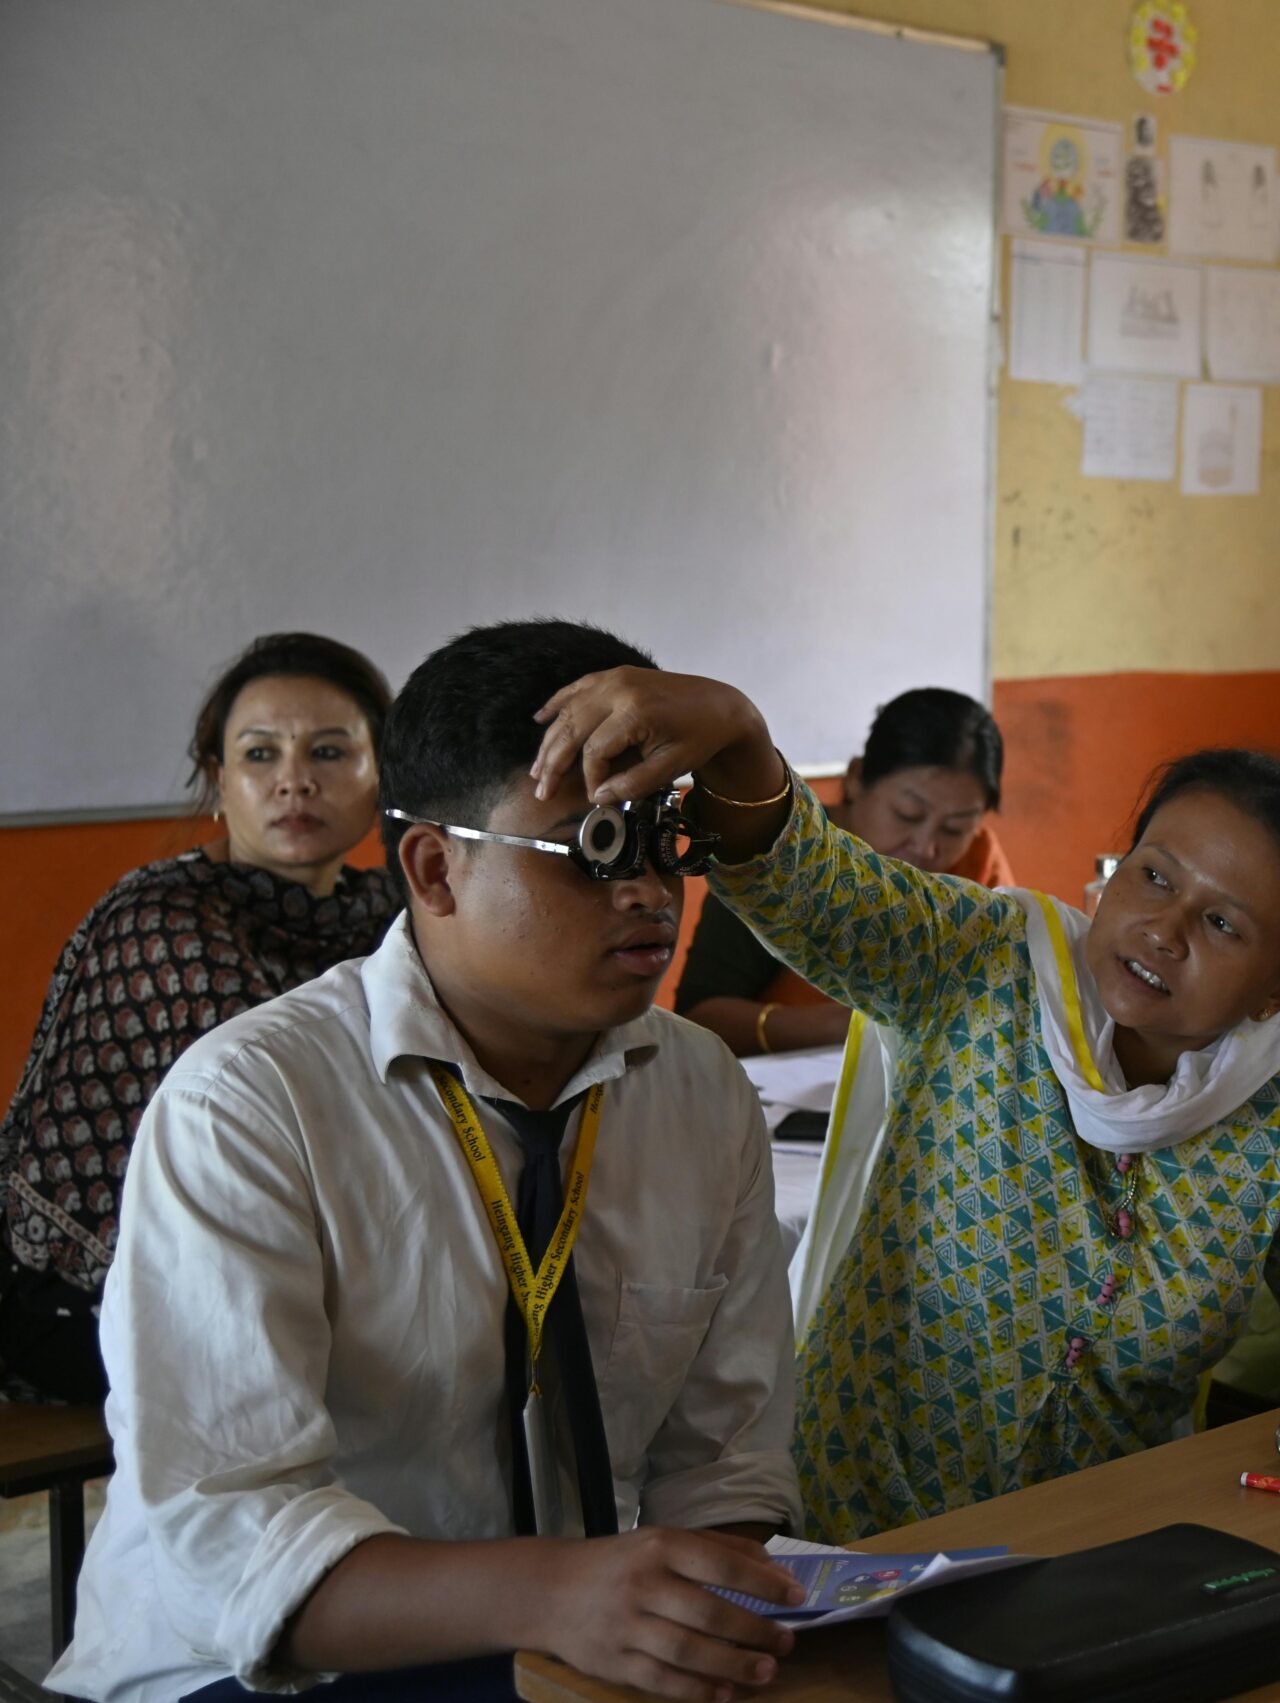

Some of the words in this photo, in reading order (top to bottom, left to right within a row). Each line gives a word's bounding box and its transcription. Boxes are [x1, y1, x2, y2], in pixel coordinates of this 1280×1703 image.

[463, 1126, 486, 1161] School
[491, 1200, 515, 1252] Heingang
[510, 1252, 528, 1289] Higher
[535, 1263, 557, 1300] Higher
[551, 1207, 578, 1261] Secondary
[571, 1171, 585, 1206] School
